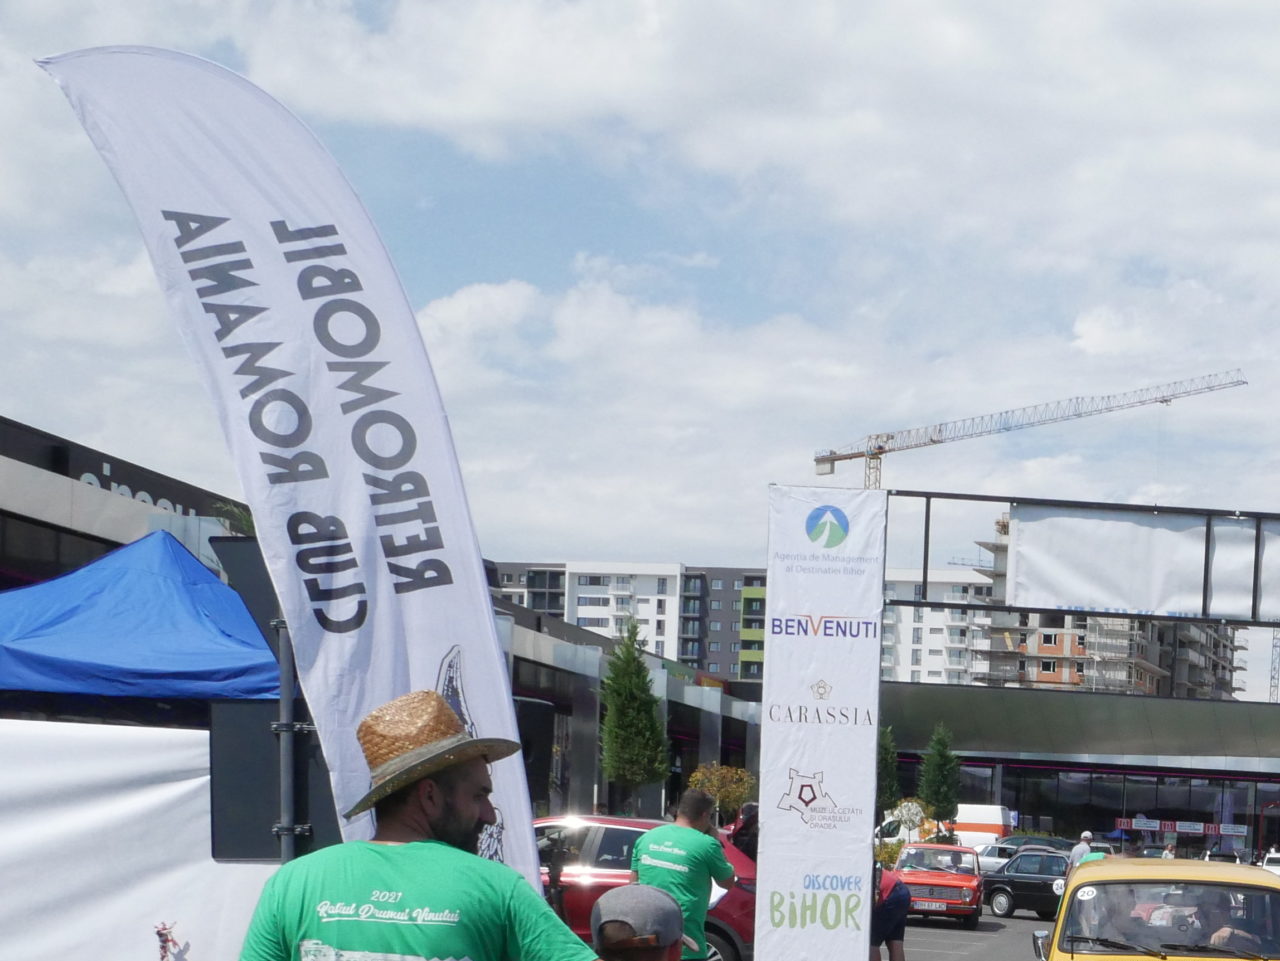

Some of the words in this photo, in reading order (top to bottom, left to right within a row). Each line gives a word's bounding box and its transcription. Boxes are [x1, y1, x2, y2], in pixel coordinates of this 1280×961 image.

[771, 615, 877, 639] BENVENUTI
[769, 704, 873, 726] CARASSIA
[370, 890, 402, 903] 2021
